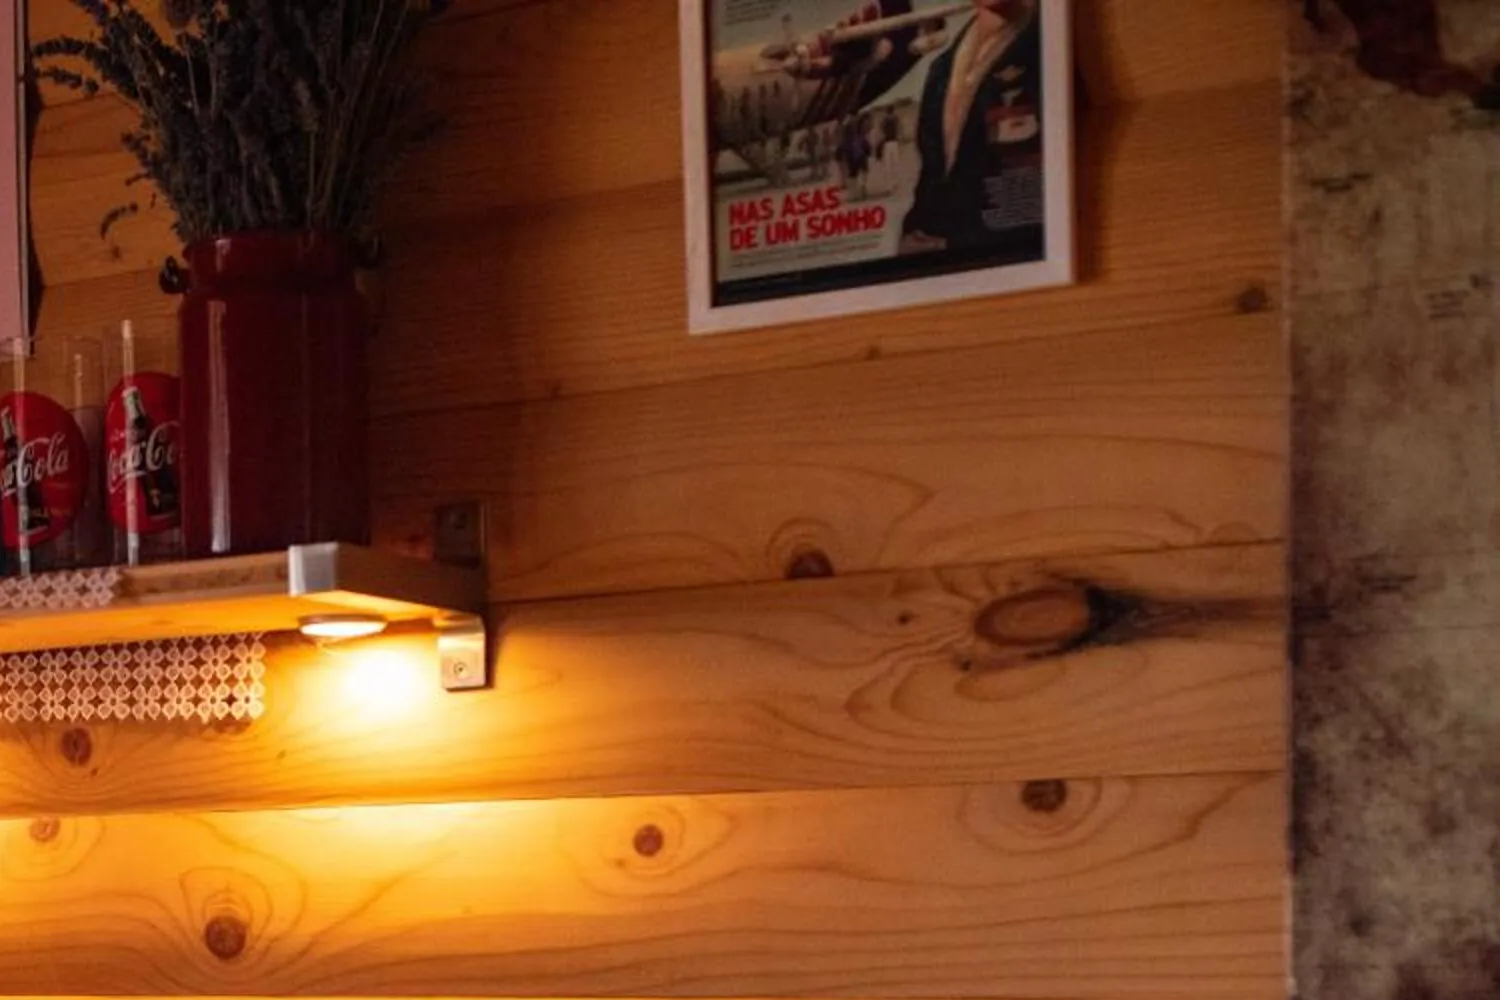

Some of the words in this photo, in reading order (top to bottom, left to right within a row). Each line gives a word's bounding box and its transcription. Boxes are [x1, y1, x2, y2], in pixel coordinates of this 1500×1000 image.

[781, 187, 842, 217] ASAS
[729, 226, 758, 251] DE
[765, 219, 800, 245] UM
[806, 207, 886, 239] SONHO
